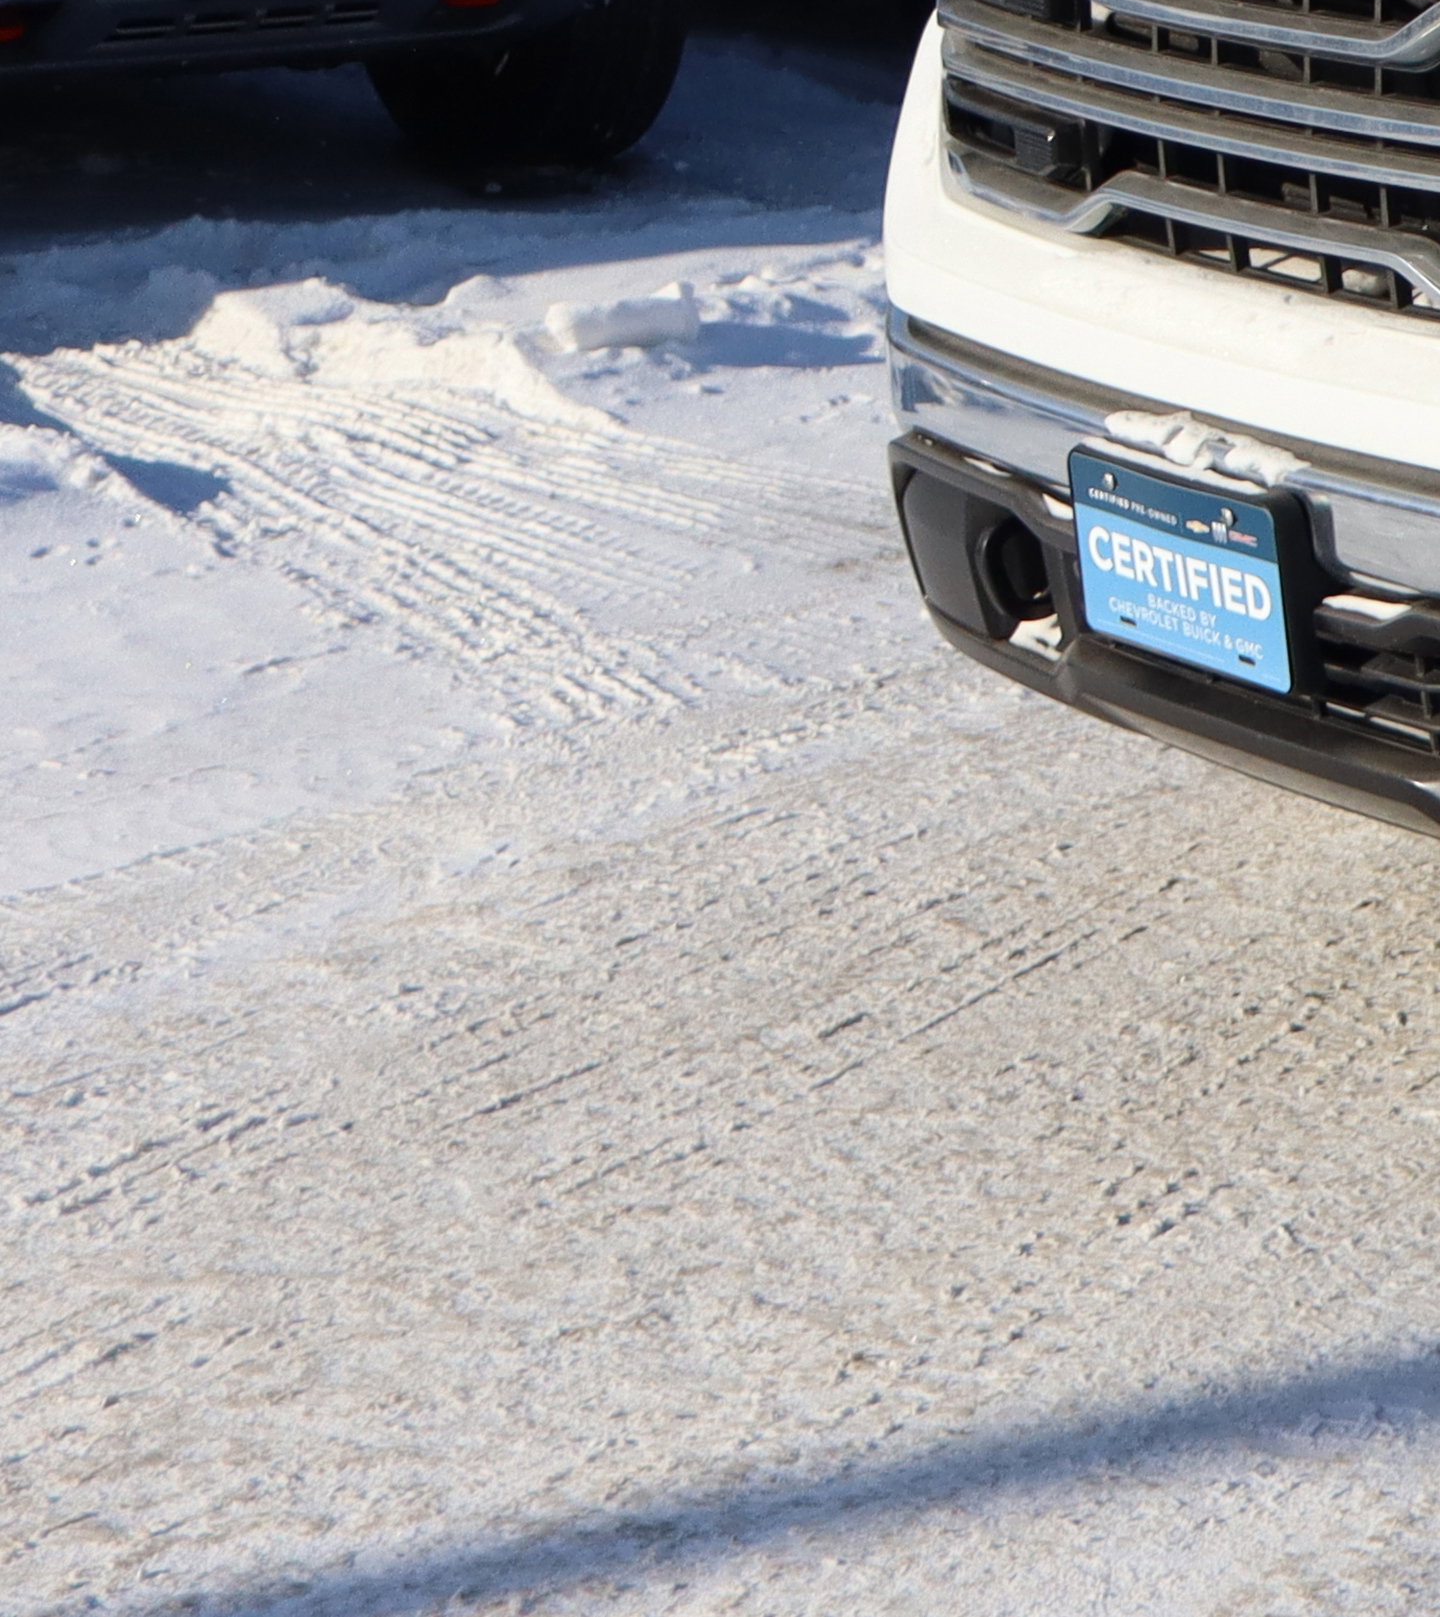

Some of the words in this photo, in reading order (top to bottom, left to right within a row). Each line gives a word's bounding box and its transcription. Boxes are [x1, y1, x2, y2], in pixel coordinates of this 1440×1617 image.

[1088, 487, 1130, 511] CERTIFIED
[1131, 501, 1178, 526] PRE-OWNED
[1088, 525, 1273, 621] CERTIFIED
[1108, 596, 1179, 632] CHEVROLET
[1183, 621, 1222, 645] BUICK
[1223, 634, 1234, 650] &
[1235, 638, 1265, 660] GMC
[1147, 593, 1196, 622] BACKED
[1200, 609, 1217, 627] BY
